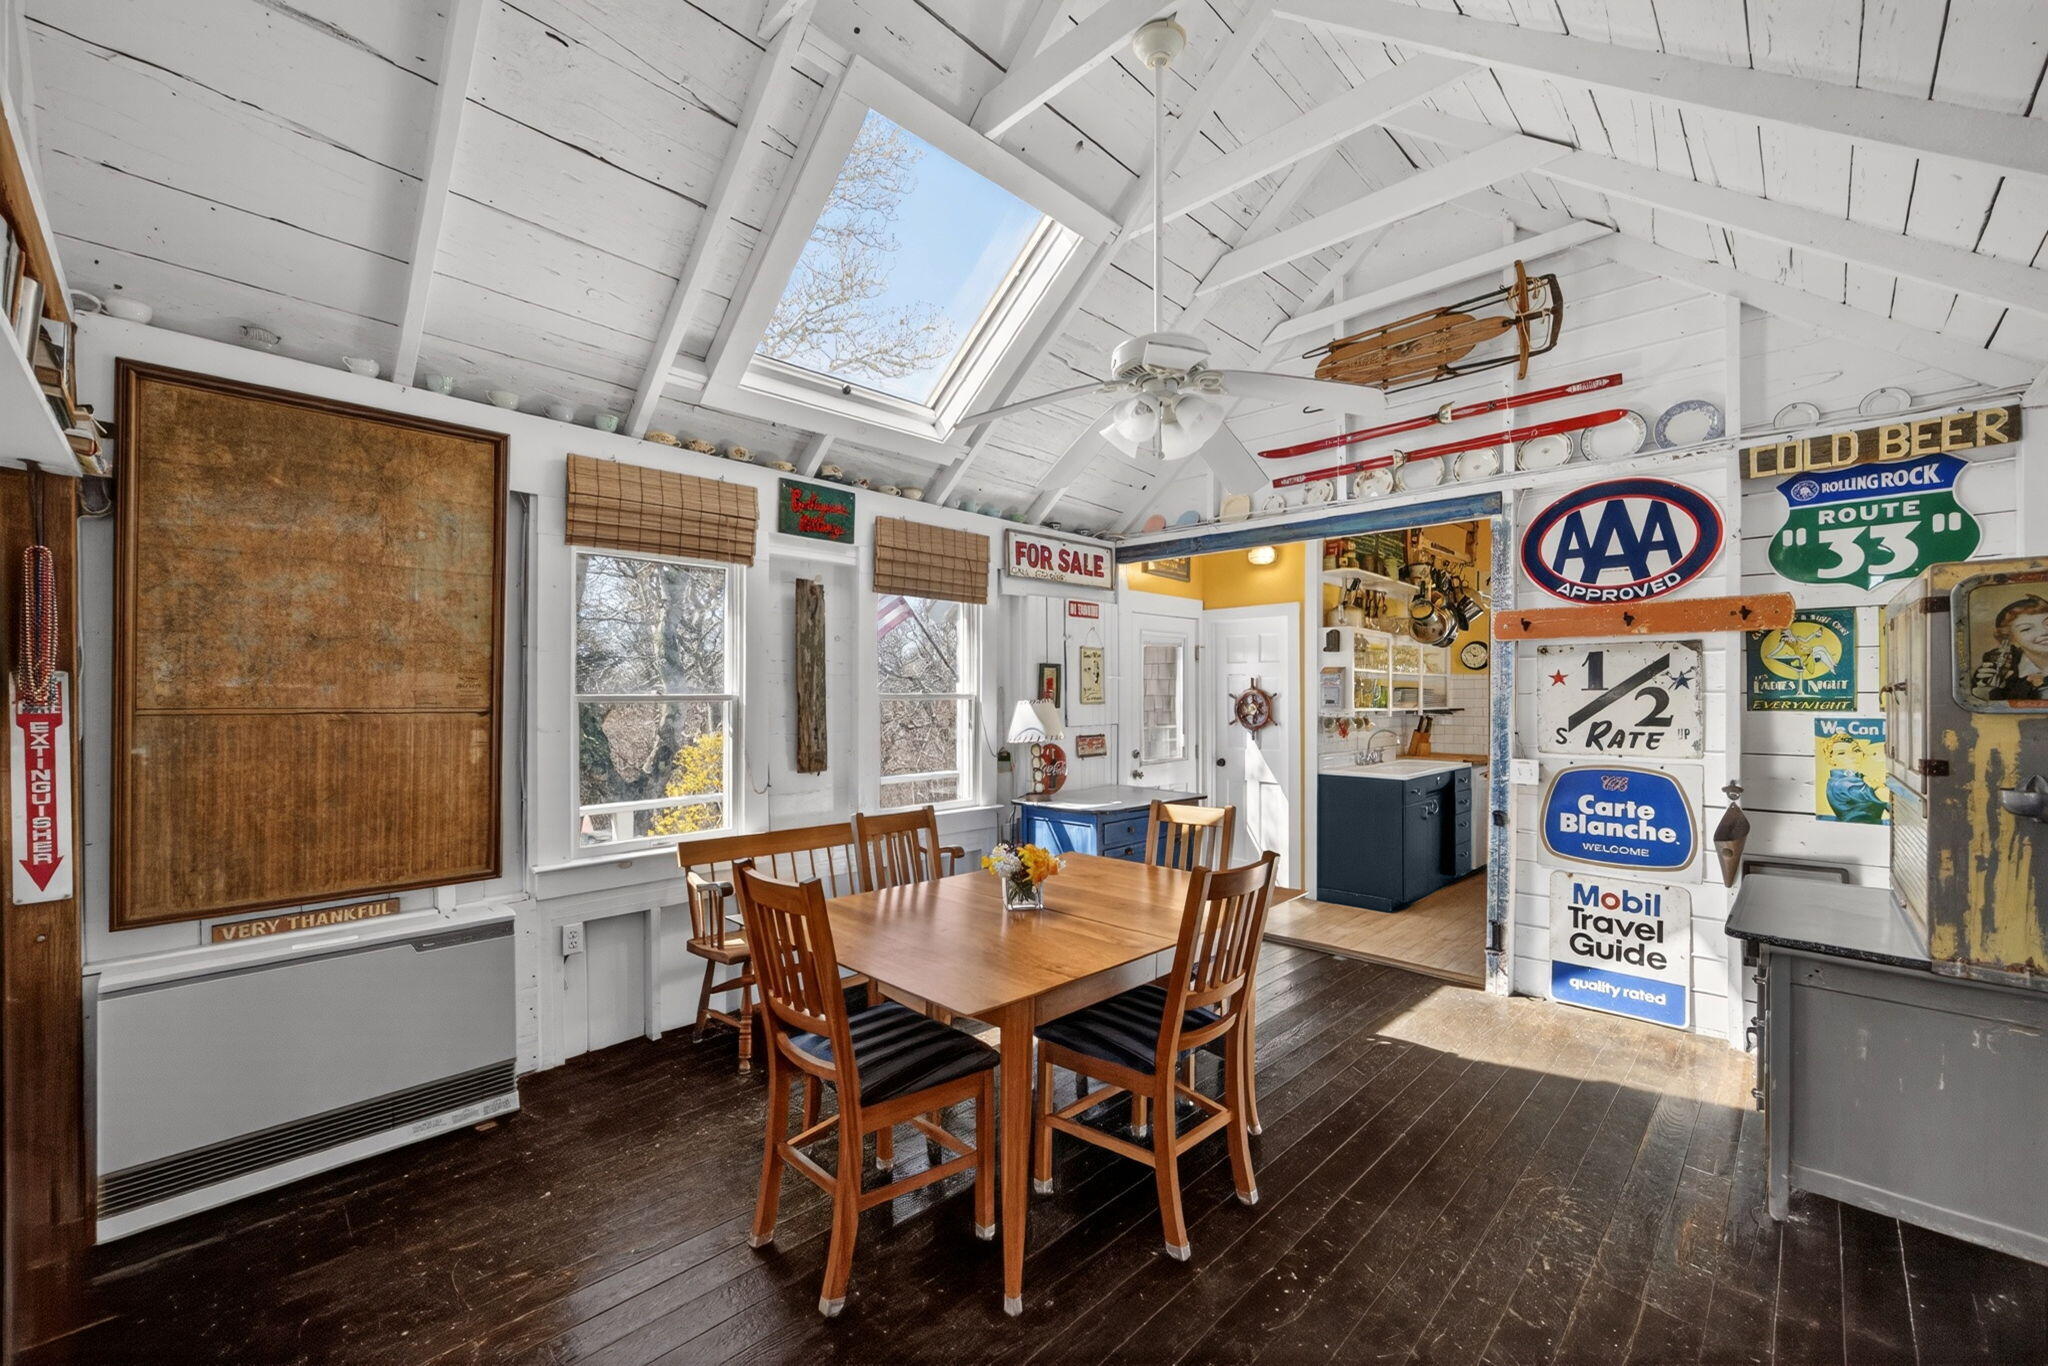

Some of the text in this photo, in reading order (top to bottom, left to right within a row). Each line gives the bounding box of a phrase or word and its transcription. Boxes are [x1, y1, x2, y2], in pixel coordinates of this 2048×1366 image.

[1750, 407, 2009, 479] COLD BEER
[1821, 473, 1878, 494] ROLLING
[1818, 500, 1920, 525] ROUTE
[1552, 499, 1683, 585] AAA
[1015, 541, 1104, 578] FOR SALE
[1556, 572, 1682, 601] APPROVED
[1753, 680, 1849, 694] LADIES NIGHT
[1753, 701, 1851, 710] EVERYNIGHT
[1585, 720, 1665, 751] RATE
[1820, 720, 1846, 734] We
[1848, 721, 1879, 735] Can
[29, 721, 53, 866] EXTINGUISHER
[1577, 794, 1656, 821] Carte
[1582, 842, 1650, 857] WELCOME
[1573, 883, 1661, 917] Mobil
[221, 902, 392, 940] VERY THANKFUL
[1567, 905, 1664, 943] Travel
[1569, 932, 1668, 970] Guide
[1569, 978, 1667, 1006] quality rated
